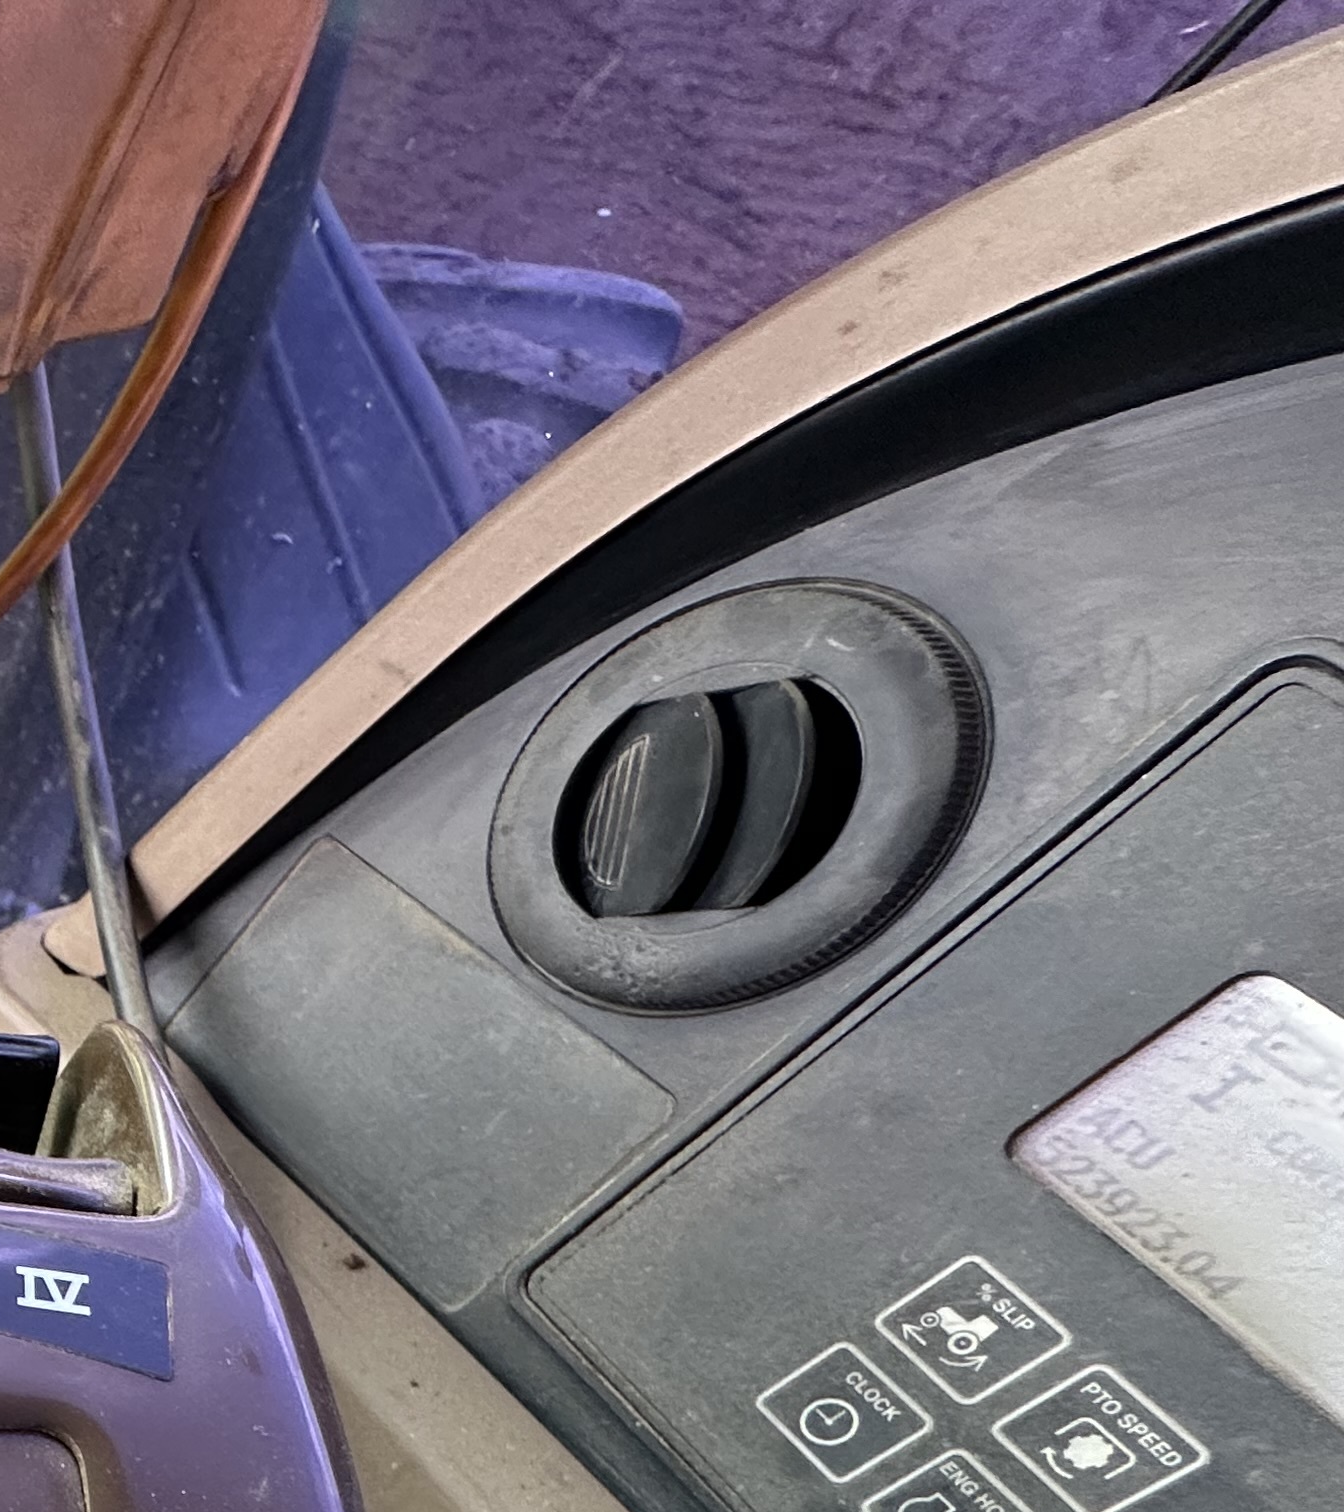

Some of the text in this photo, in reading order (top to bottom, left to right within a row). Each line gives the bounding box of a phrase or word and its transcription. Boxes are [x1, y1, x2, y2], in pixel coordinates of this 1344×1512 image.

[992, 1298, 1036, 1332] SLIP
[845, 1371, 901, 1422] CLOCK
[1079, 1381, 1182, 1468] PTO SPEED
[938, 1461, 976, 1500] ENG
